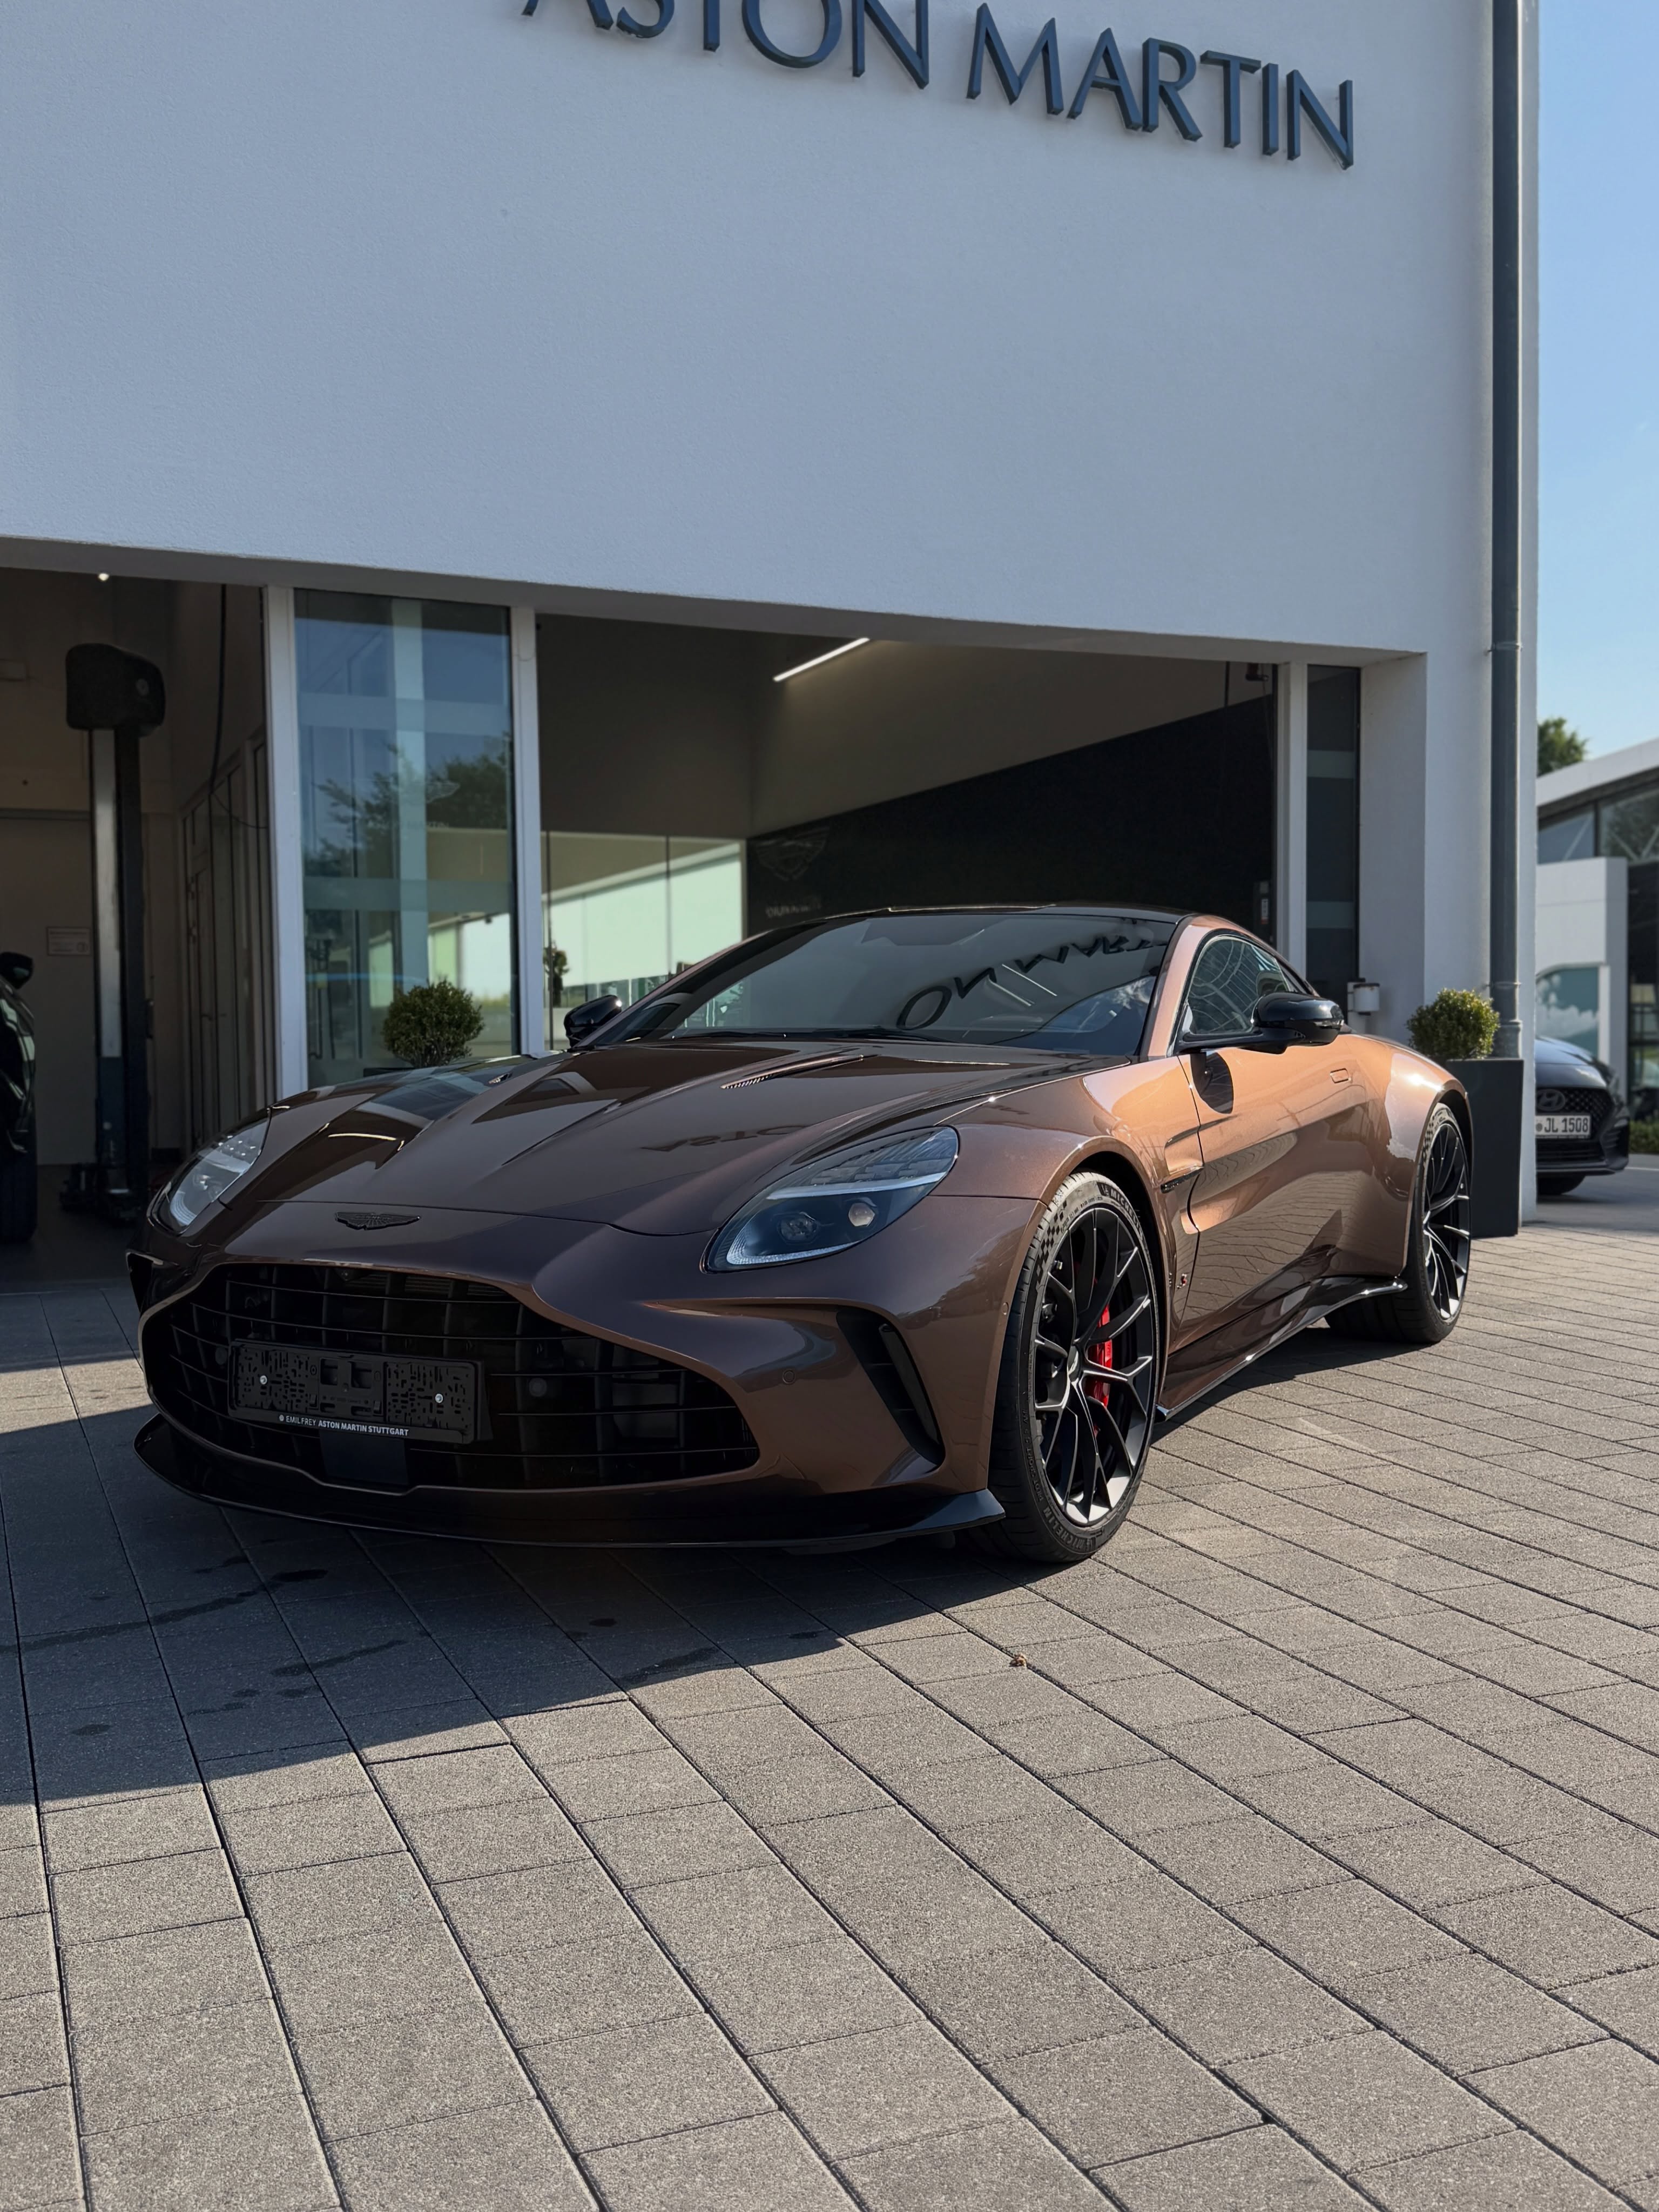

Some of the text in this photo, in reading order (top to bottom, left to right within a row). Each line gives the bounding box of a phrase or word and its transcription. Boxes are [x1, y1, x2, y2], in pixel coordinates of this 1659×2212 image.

[966, 2, 1354, 170] MARTIN
[1544, 1117, 1589, 1133] JL 1508
[318, 1420, 340, 1429] ASTON
[341, 1423, 367, 1432] MARTIN
[368, 1426, 409, 1436] STUTTGART
[1026, 1447, 1036, 1478] SPORT
[1043, 1506, 1085, 1550] MICHELIN
